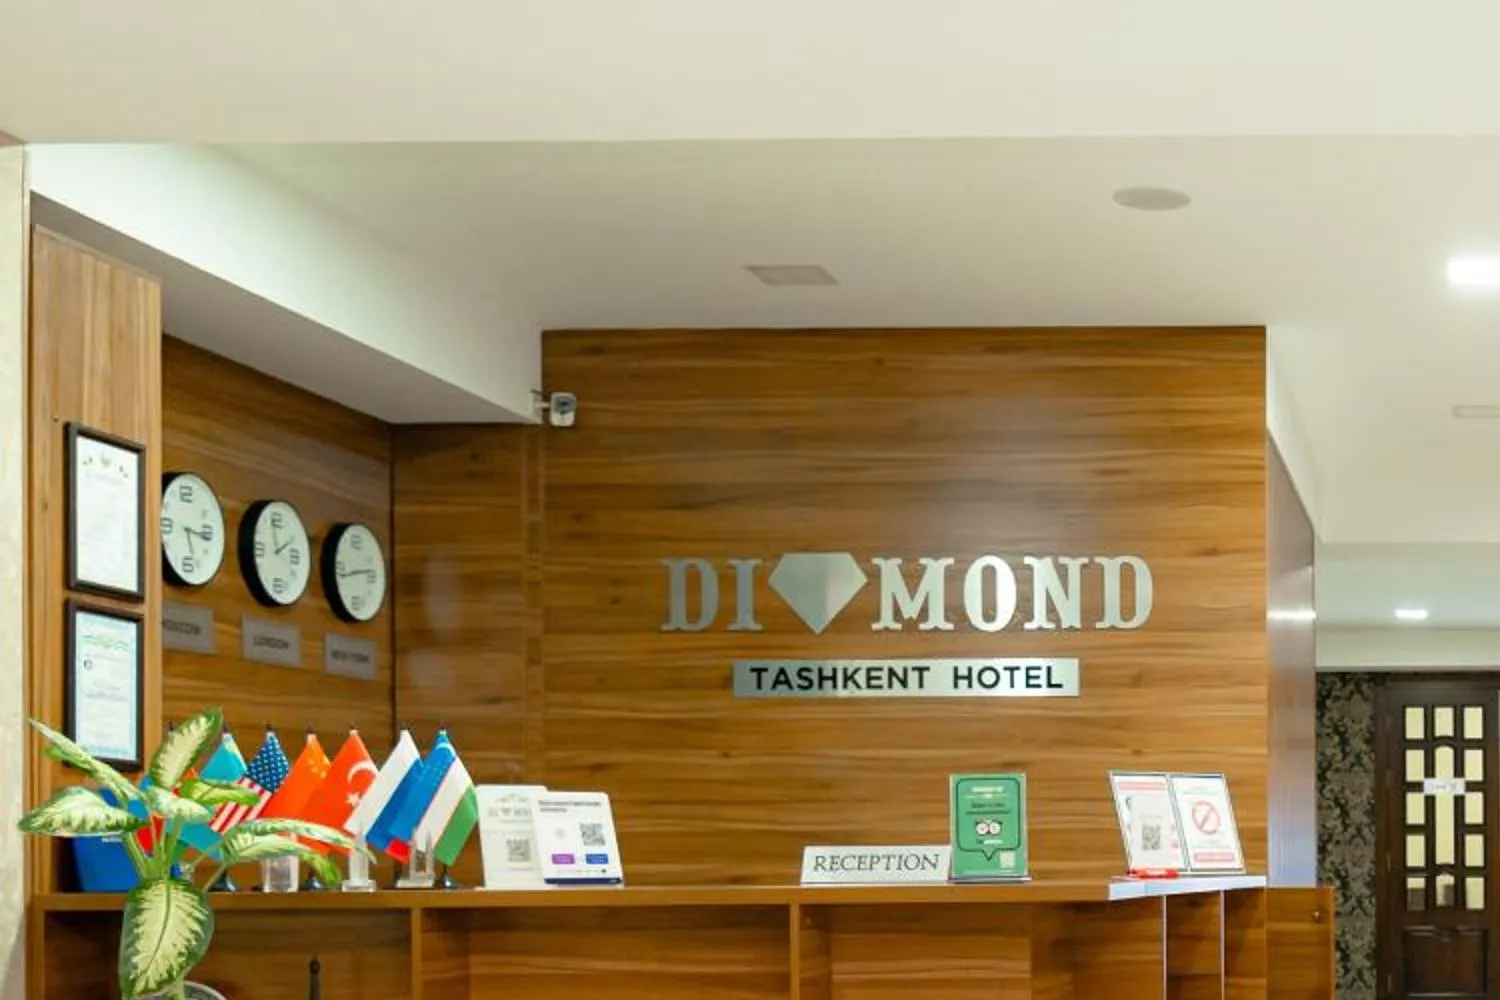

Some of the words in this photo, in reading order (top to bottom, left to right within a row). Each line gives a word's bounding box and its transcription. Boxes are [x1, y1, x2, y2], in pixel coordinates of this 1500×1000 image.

[749, 667, 930, 691] TASHKENT
[953, 665, 1064, 690] HOTEL
[813, 853, 940, 872] RECEPTION
